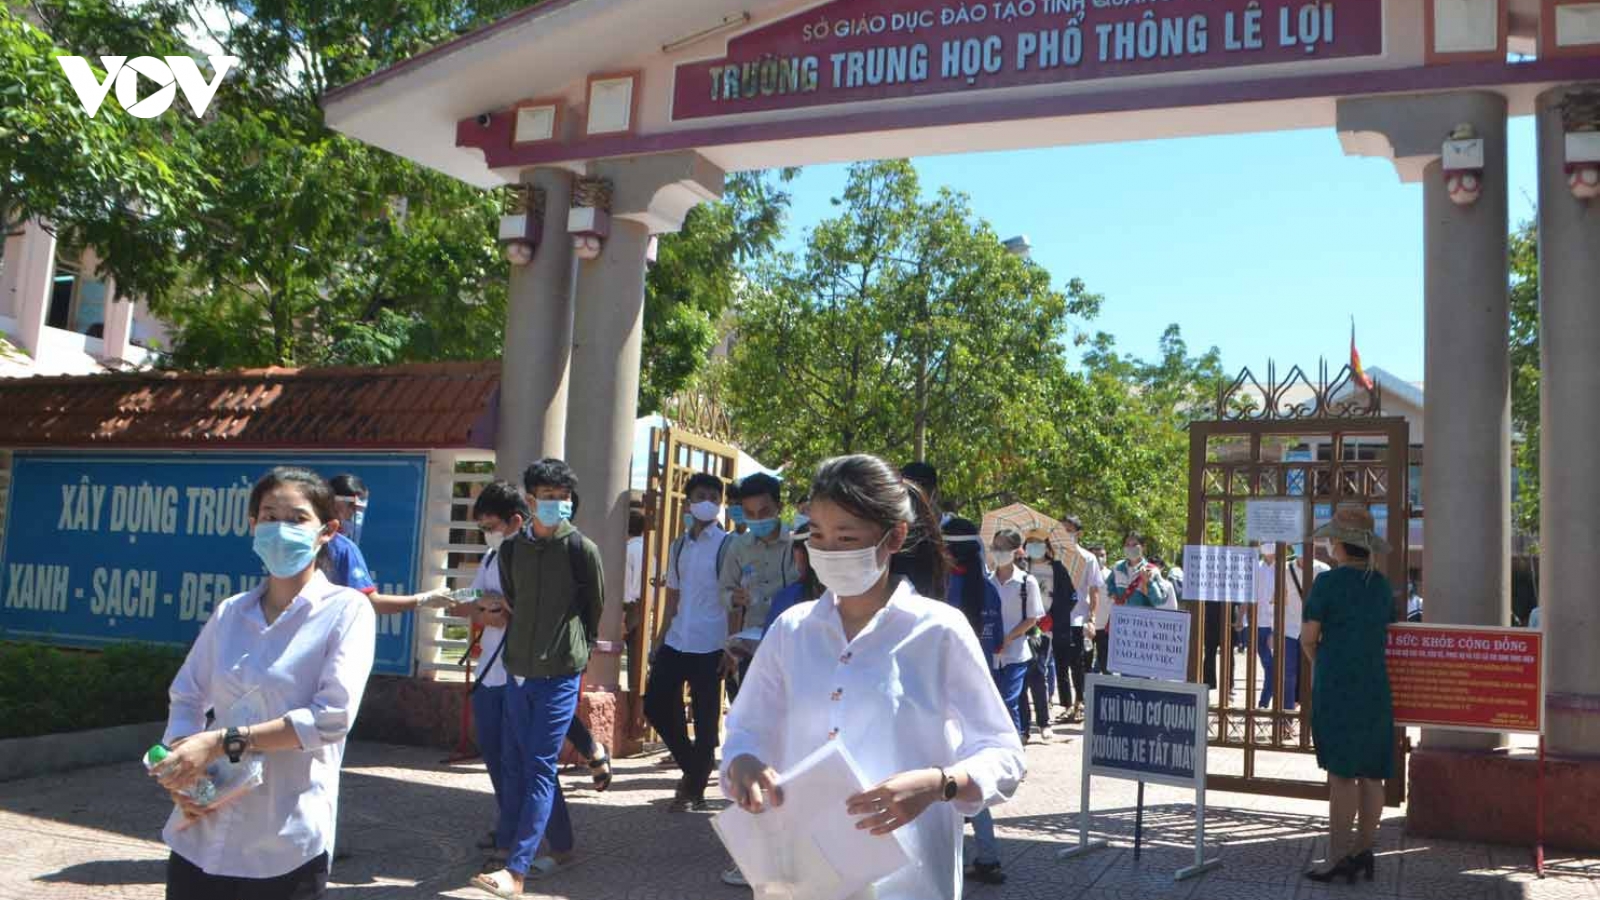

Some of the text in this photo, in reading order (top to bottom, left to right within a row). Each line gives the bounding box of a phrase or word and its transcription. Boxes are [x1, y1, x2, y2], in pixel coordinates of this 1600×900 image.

[803, 16, 829, 41] SỞ
[834, 14, 886, 37] GIÁO
[891, 11, 934, 33] DỤC
[941, 2, 987, 24] ĐÀO
[993, 0, 1035, 22] TẠO
[830, 45, 929, 88] TRUNG
[941, 35, 1002, 85] HỌC
[1016, 13, 1085, 70] PHỔ
[1095, 10, 1208, 62] THÔNG
[1224, 0, 1262, 50] LÊ
[1279, 0, 1333, 52] LỢI
[58, 475, 254, 544] XÂY DỰNG TRƯỜ
[5, 562, 69, 612] XANH
[90, 567, 157, 626] SẠCH
[1123, 693, 1143, 725] VÀO
[1146, 700, 1162, 726] CƠ
[1163, 703, 1196, 732] QUAN
[1092, 726, 1129, 761] XUỐNG
[1131, 738, 1146, 763] XE
